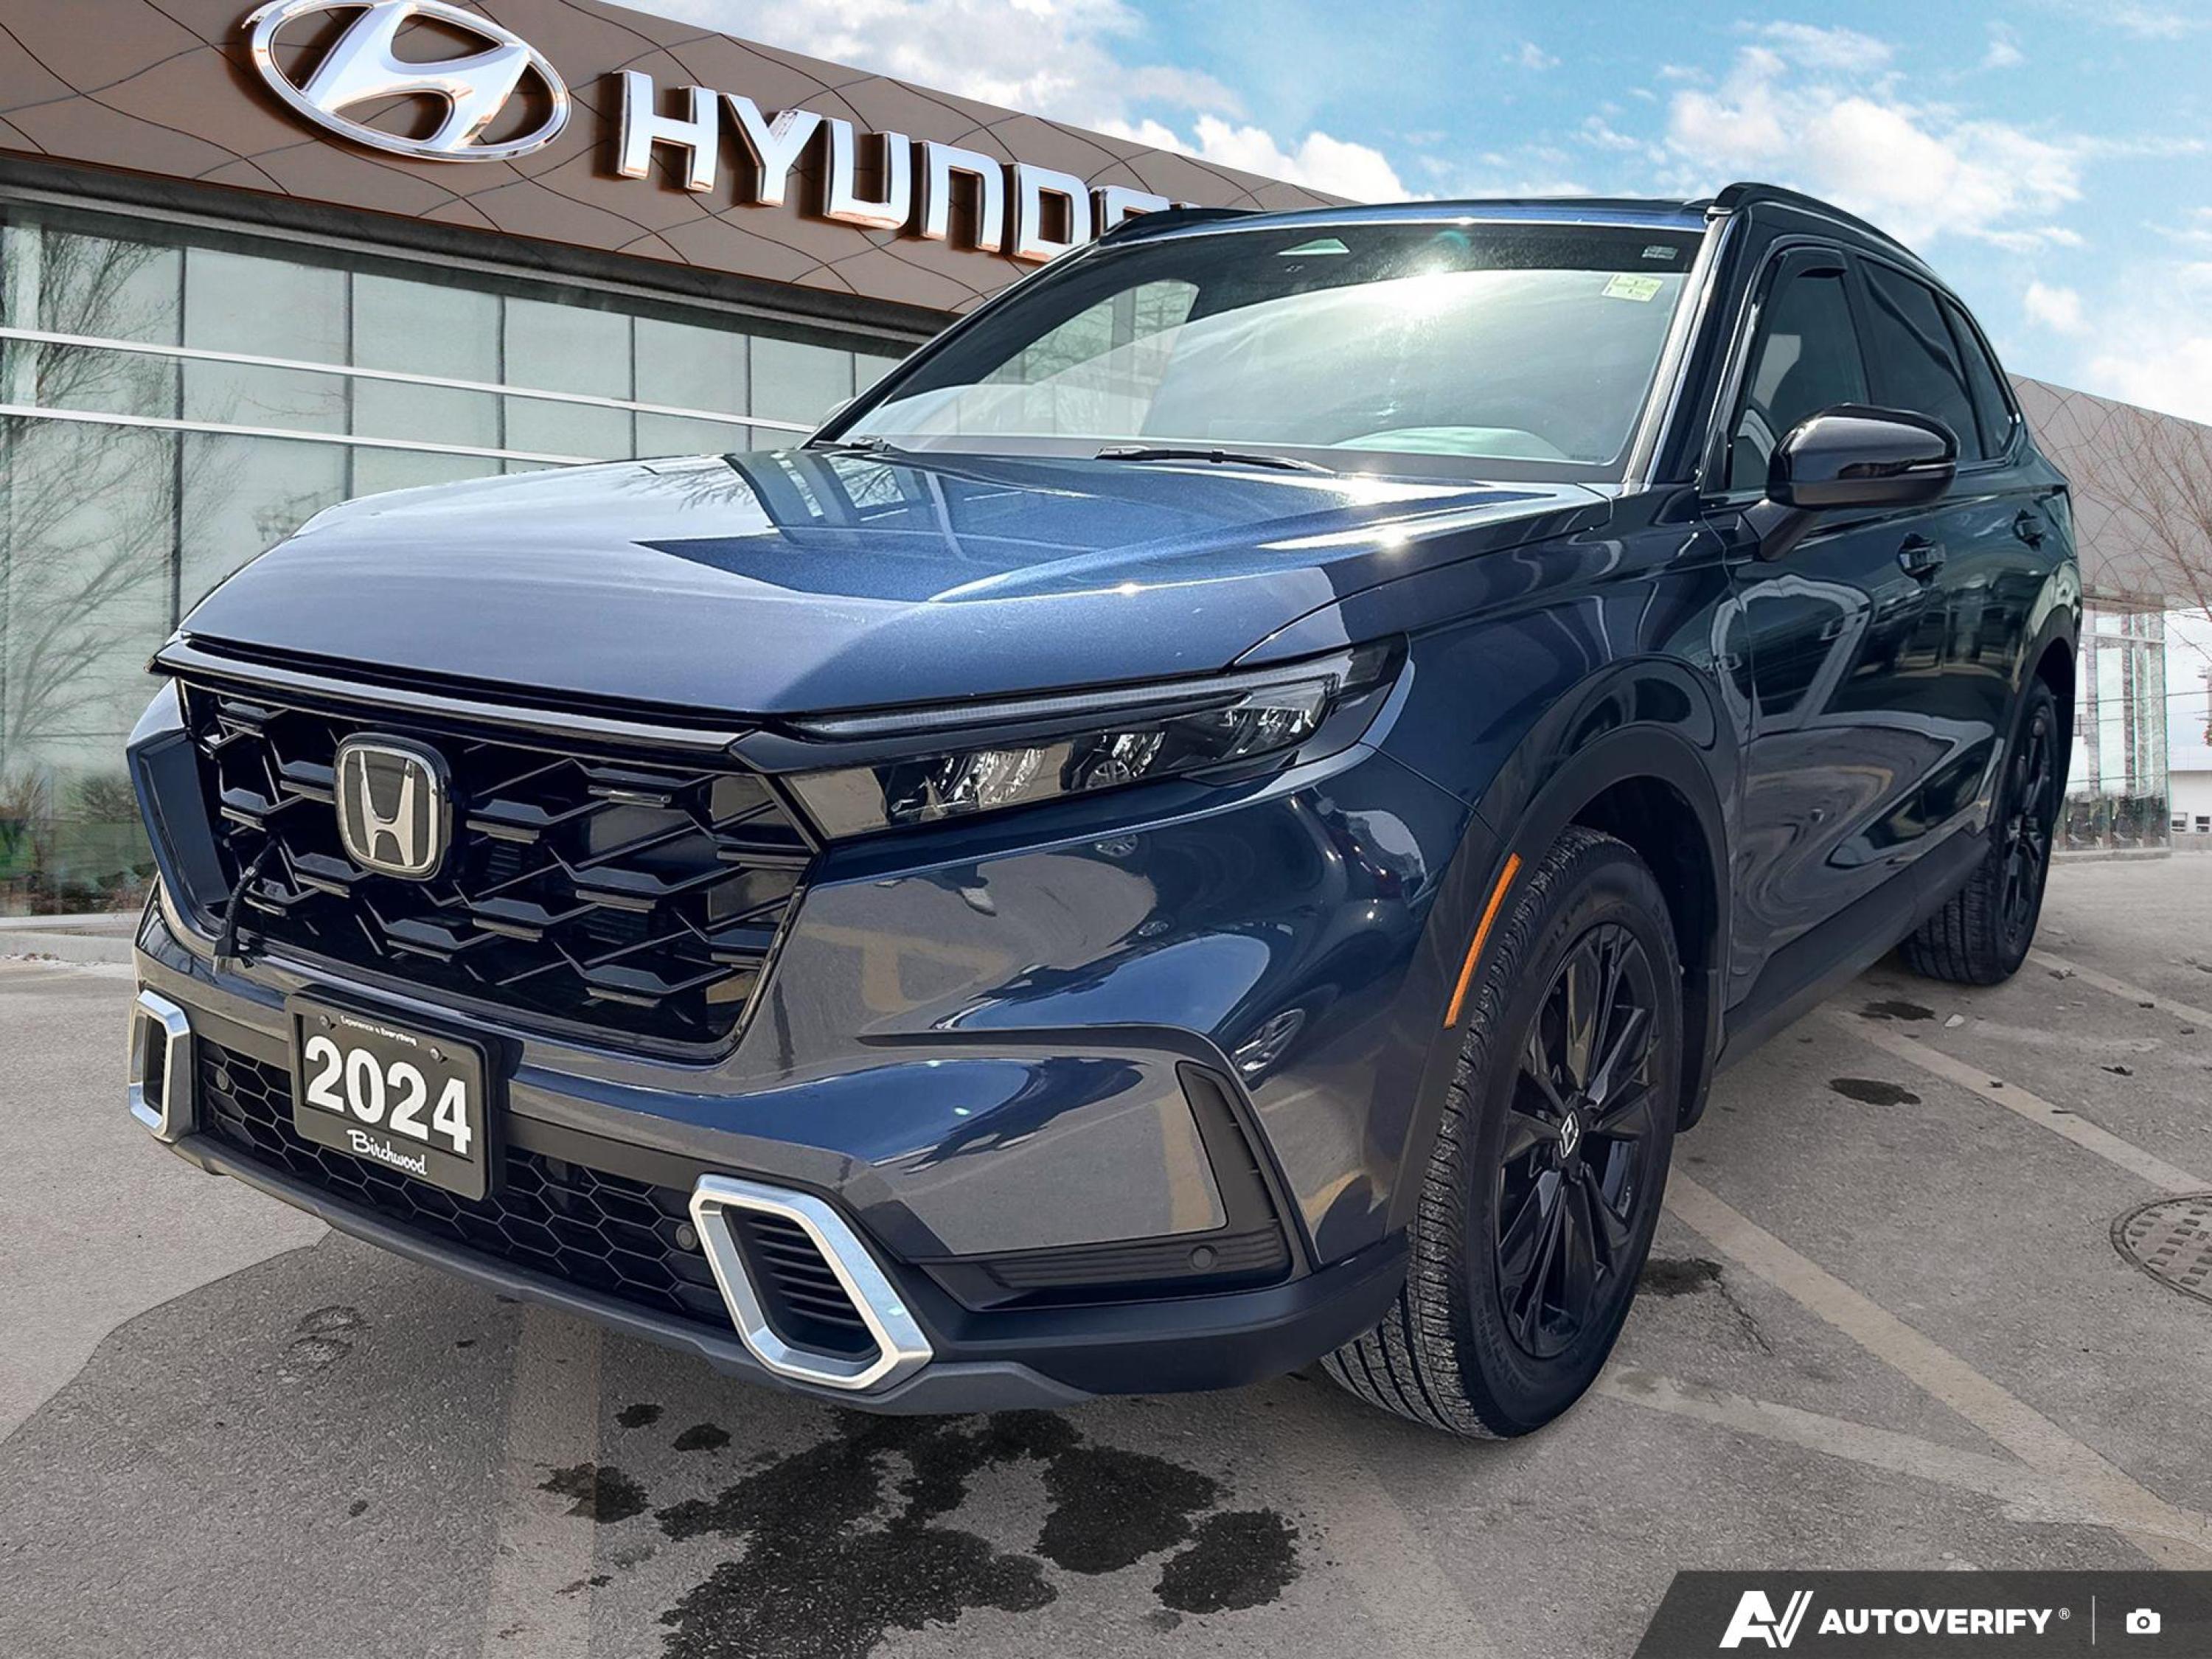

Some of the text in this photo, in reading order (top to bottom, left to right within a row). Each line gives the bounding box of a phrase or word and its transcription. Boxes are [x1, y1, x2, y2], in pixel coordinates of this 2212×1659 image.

[614, 70, 1200, 263] HYUND
[305, 1036, 471, 1155] 2024
[346, 1129, 428, 1175] Birchwood
